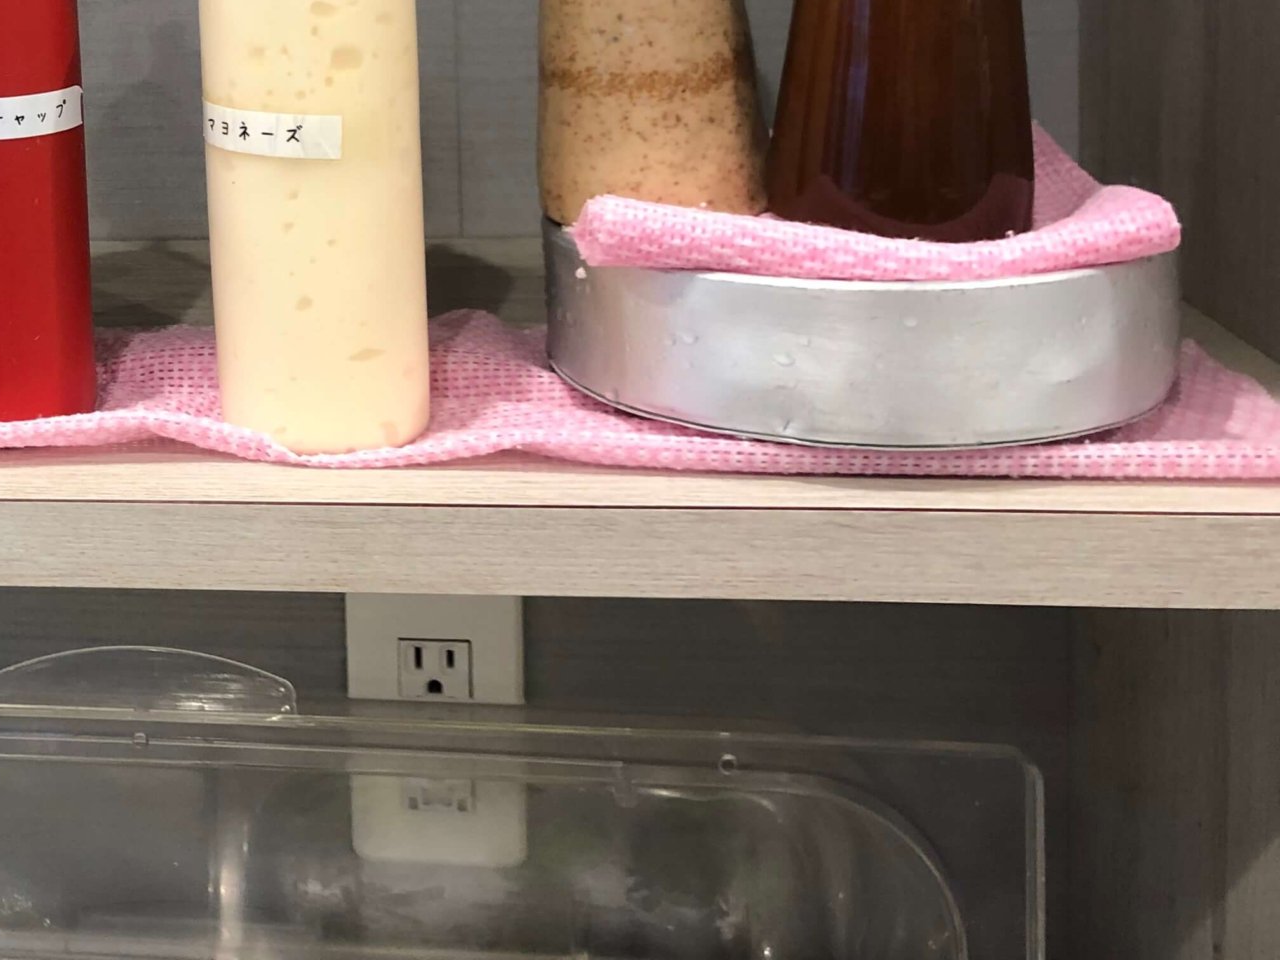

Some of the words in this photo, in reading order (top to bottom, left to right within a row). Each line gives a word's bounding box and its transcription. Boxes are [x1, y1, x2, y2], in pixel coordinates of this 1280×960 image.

[208, 119, 303, 143] マヨネーズ
